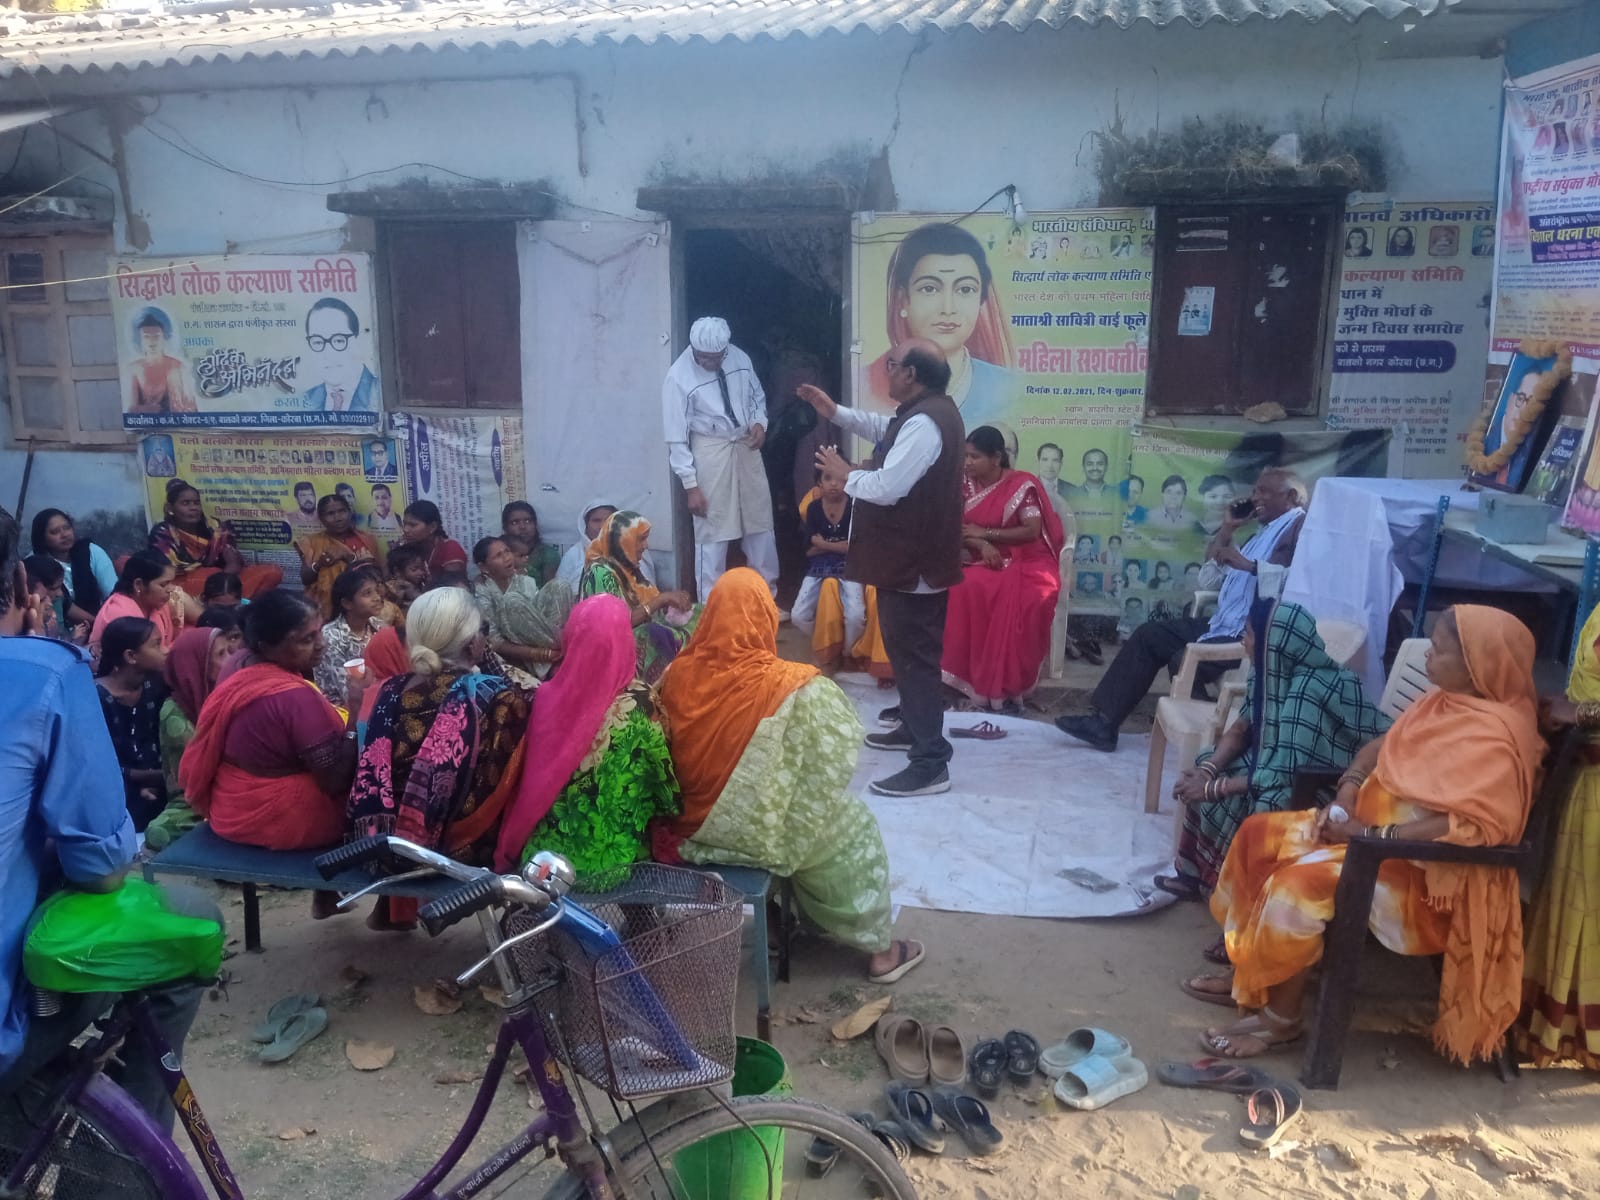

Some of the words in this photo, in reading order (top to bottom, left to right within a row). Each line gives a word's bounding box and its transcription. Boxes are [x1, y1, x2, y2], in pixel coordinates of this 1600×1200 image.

[1032, 217, 1079, 233] भारतीय
[1081, 216, 1137, 234] संविधान,
[1557, 227, 1584, 241] धरना
[116, 261, 177, 300] सिद्धार्थ
[181, 262, 221, 296] लोक
[226, 269, 293, 295] कल्याण
[297, 258, 358, 294] समिति
[1012, 270, 1045, 283] सिद्धार्थ
[1047, 270, 1069, 282] लोक
[1071, 270, 1106, 282] कल्याण
[1111, 269, 1142, 281] समिति
[1344, 269, 1406, 282] कल्याण
[1411, 266, 1465, 282] समिति
[1013, 291, 1036, 302] भारत
[1040, 291, 1054, 301] देश
[1073, 291, 1095, 302] प्रथम
[1100, 290, 1129, 302] महिला
[1371, 286, 1384, 300] में
[1343, 304, 1379, 321] मुक्ति
[1383, 303, 1416, 318] मोर्चा
[1419, 304, 1435, 317] के
[204, 319, 227, 329] शासन
[228, 319, 244, 329] द्वारा
[1011, 312, 1053, 327] माताश्री
[1055, 312, 1096, 327] सावित्री
[1099, 311, 1121, 328] बाई
[1123, 312, 1148, 330] फूले
[1338, 322, 1368, 335] जन्म
[1372, 321, 1409, 335] दिवस
[1412, 320, 1465, 335] समारोह
[184, 336, 214, 346] आपका
[1017, 341, 1073, 374] महिला
[1365, 358, 1385, 367] नगर
[1026, 385, 1050, 395] दिनांक
[202, 435, 233, 446] बालको
[420, 441, 430, 471] अपील
